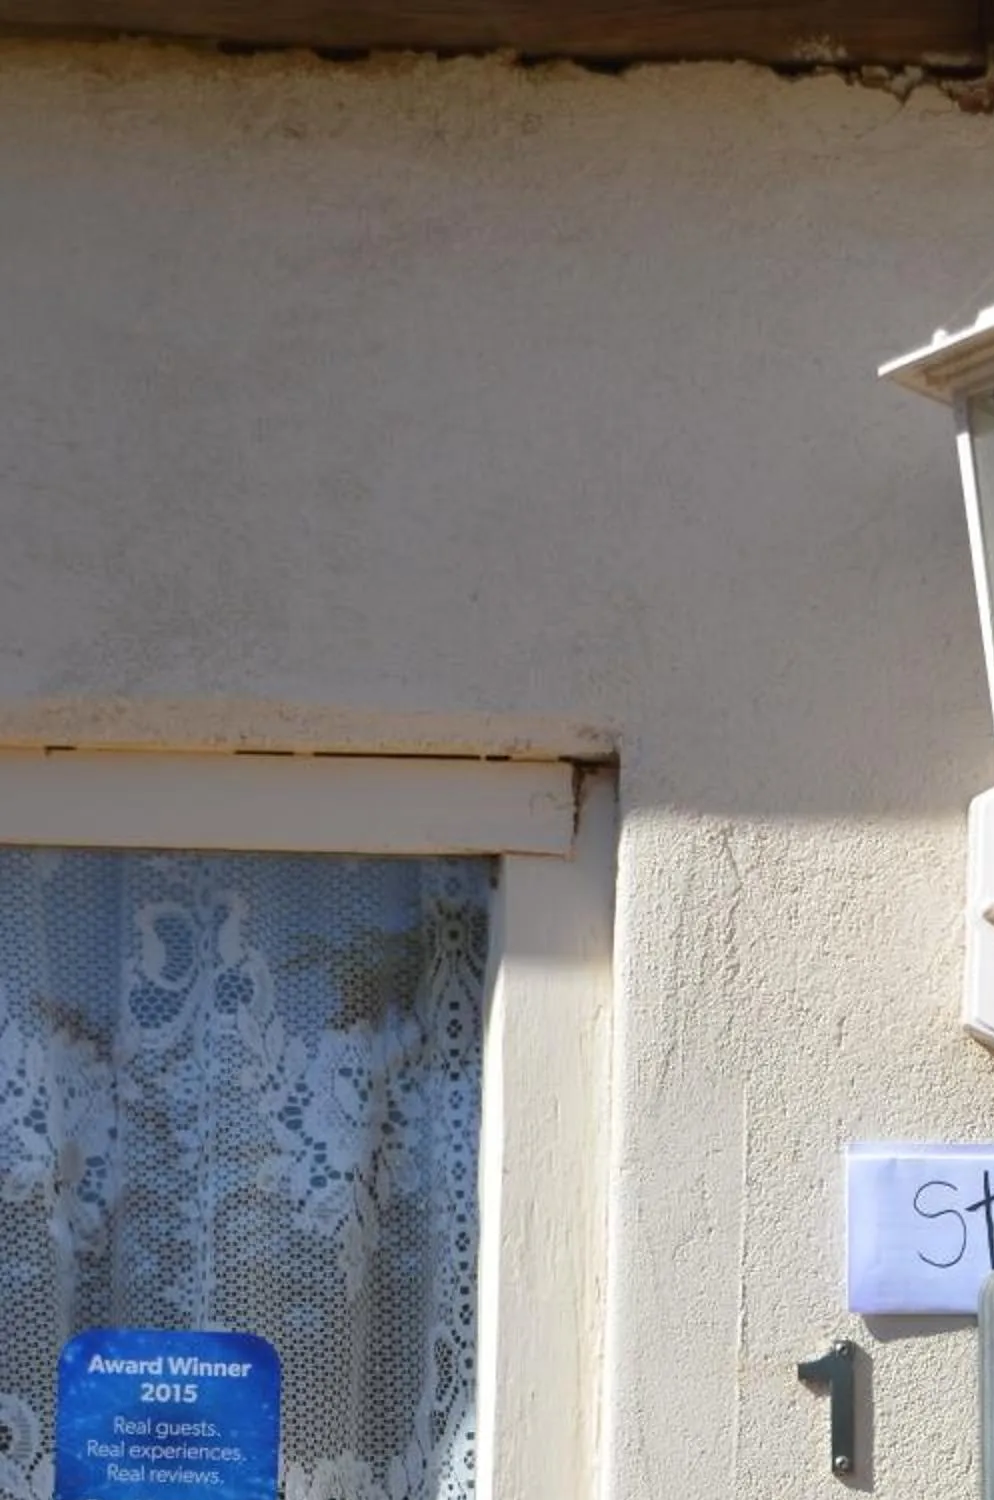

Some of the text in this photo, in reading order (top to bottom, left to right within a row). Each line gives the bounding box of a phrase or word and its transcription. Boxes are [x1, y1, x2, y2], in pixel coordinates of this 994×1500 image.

[88, 1354, 252, 1378] Award Winner
[140, 1383, 199, 1403] 2015
[798, 1340, 855, 1477] 1
[113, 1416, 221, 1440] Real guests.
[87, 1440, 247, 1464] Real experiences.
[107, 1464, 225, 1485] Real reviews.
